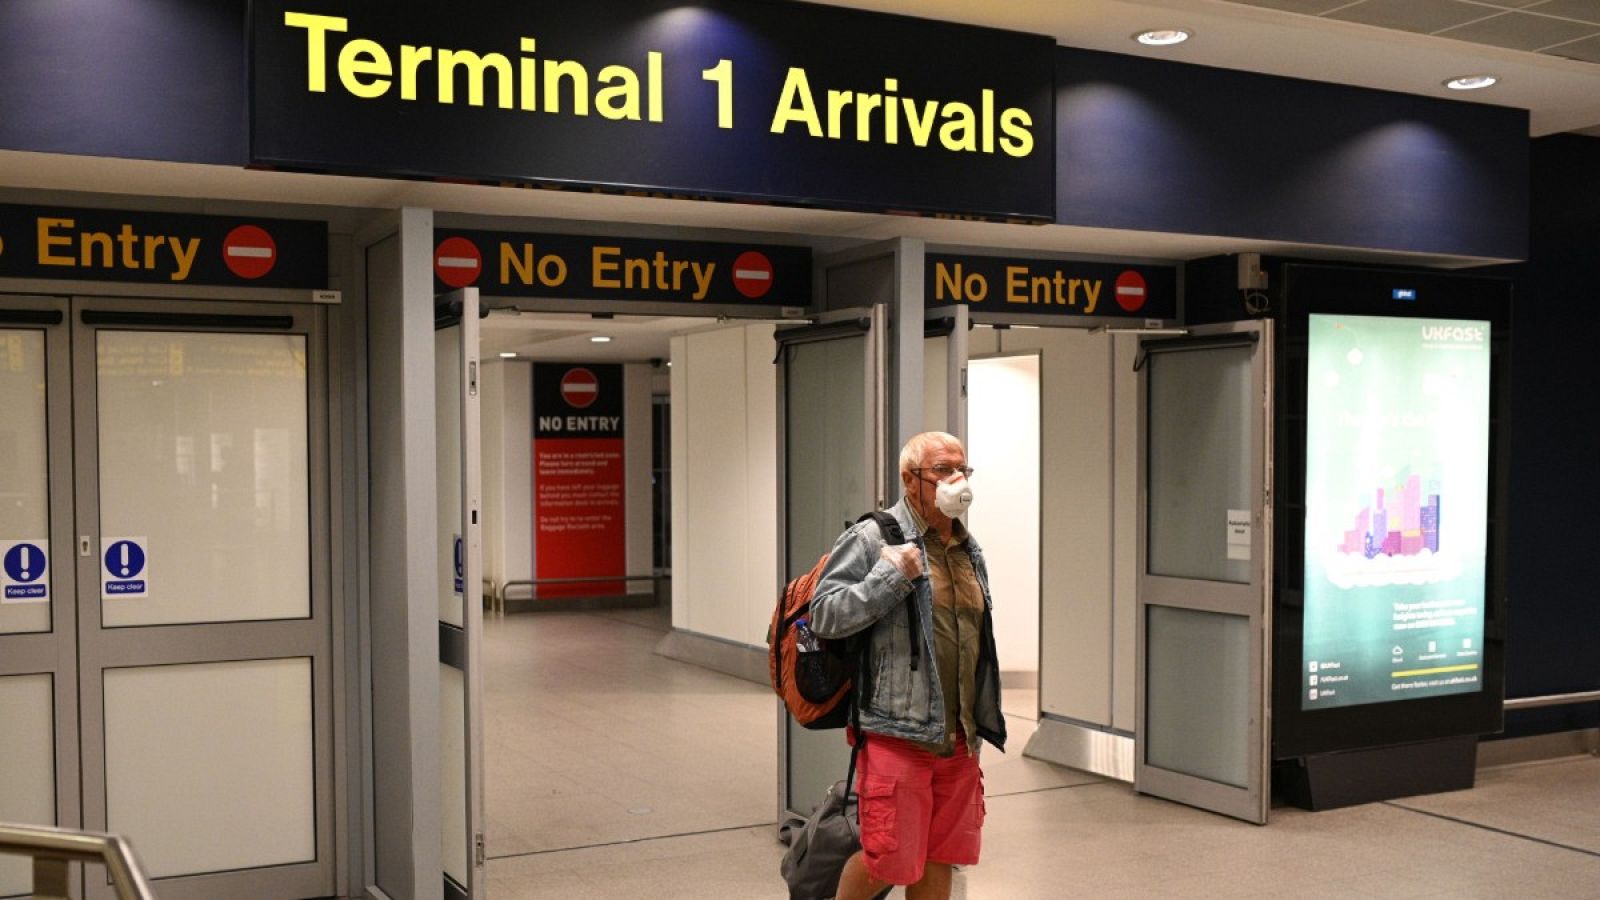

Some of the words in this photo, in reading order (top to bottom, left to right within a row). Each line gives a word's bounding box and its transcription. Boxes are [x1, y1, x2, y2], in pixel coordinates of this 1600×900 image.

[284, 11, 664, 123] Terminal
[702, 59, 734, 130] 1
[770, 66, 1035, 158] Arrivals
[36, 216, 201, 282] Entry
[500, 242, 568, 288] No
[591, 246, 716, 303] Entry
[935, 262, 989, 303] No
[1006, 266, 1103, 315] Entry
[539, 416, 562, 432] NO
[567, 416, 620, 432] ENTRY
[7, 587, 26, 596] Keep
[27, 586, 44, 594] clear
[107, 583, 126, 592] Keep
[126, 582, 143, 590] clear
